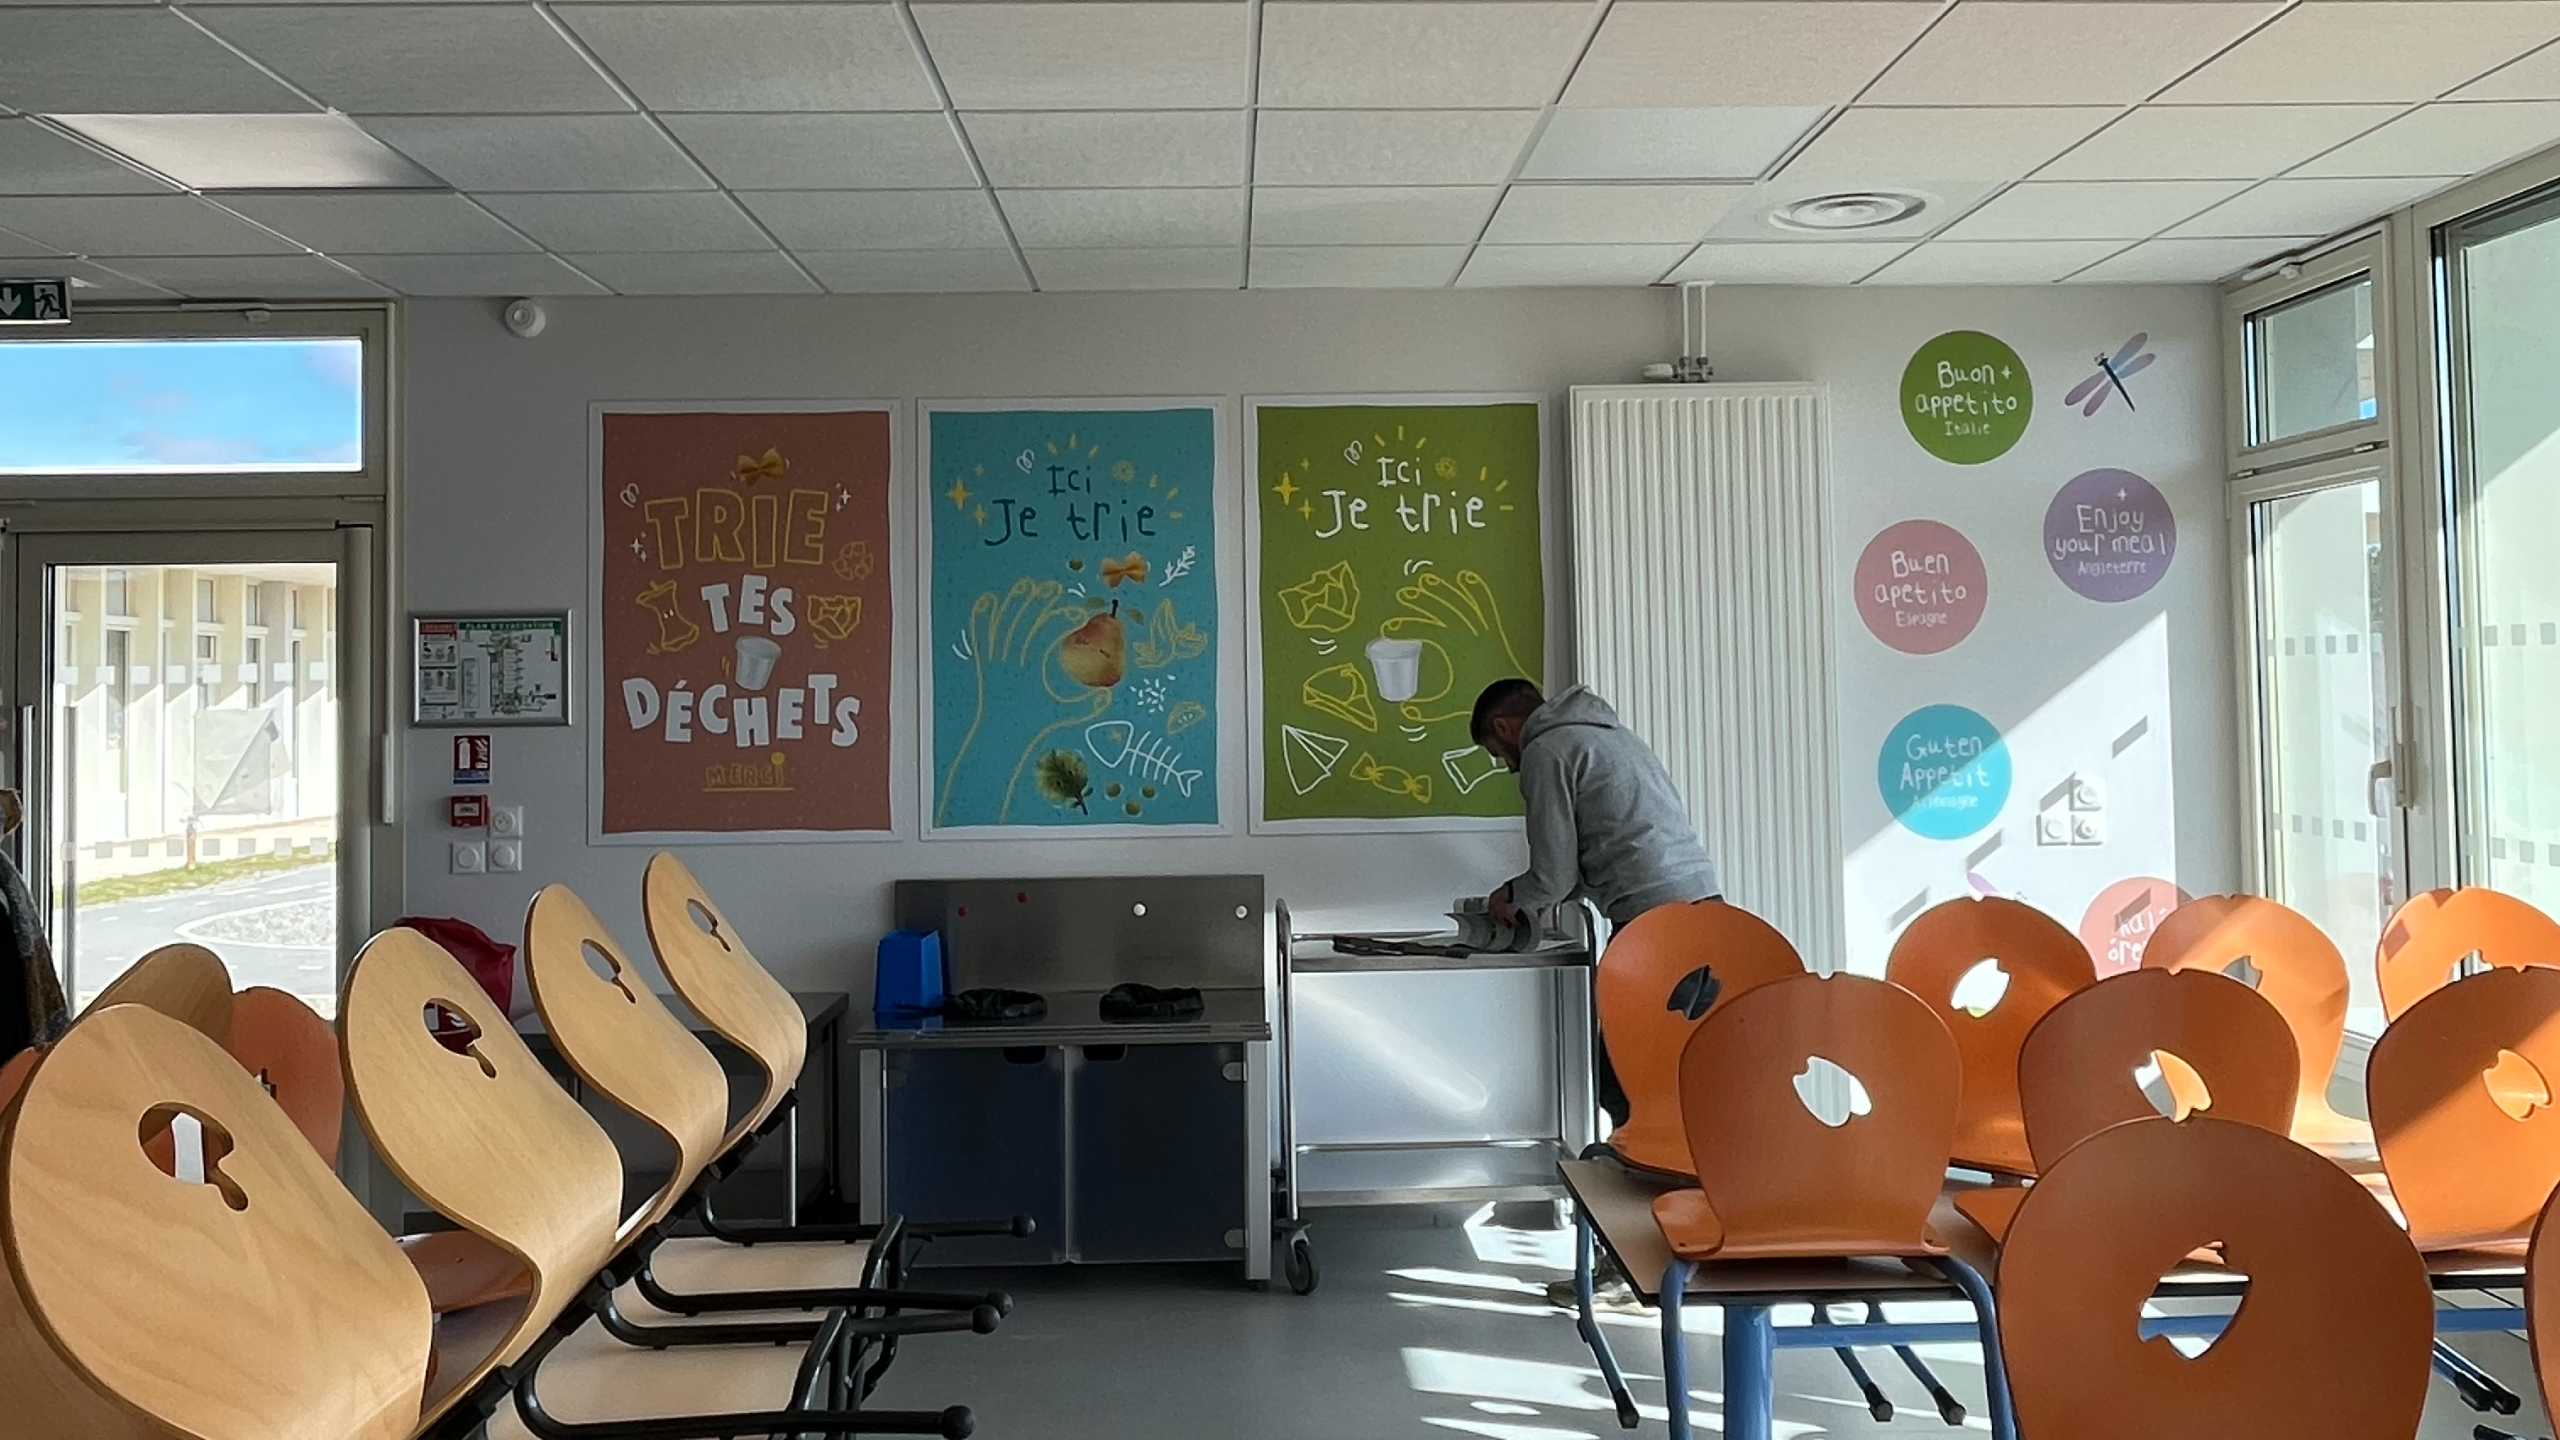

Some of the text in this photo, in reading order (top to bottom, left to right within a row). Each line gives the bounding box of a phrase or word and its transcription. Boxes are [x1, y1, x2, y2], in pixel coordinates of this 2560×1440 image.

[1937, 360, 1995, 389] Buon
[1915, 391, 2017, 418] appetito
[1944, 420, 1990, 437] Italie
[1047, 465, 1092, 496] Ici
[1376, 456, 1422, 488] Ici
[984, 498, 1156, 546] Je trie
[1315, 489, 1486, 538] Je trie
[2075, 503, 2145, 534] Enjoy
[644, 488, 828, 570] TRIE
[2053, 532, 2166, 560] your meal
[1890, 550, 1949, 578] Buen
[2077, 560, 2147, 578] Angleterre
[701, 574, 796, 635] TES
[1874, 580, 1967, 607] apetito
[1895, 610, 1947, 628] Espagne
[621, 673, 861, 748] DÉCHETS
[1906, 733, 1984, 760] Guten
[1900, 761, 1989, 791] Appetit
